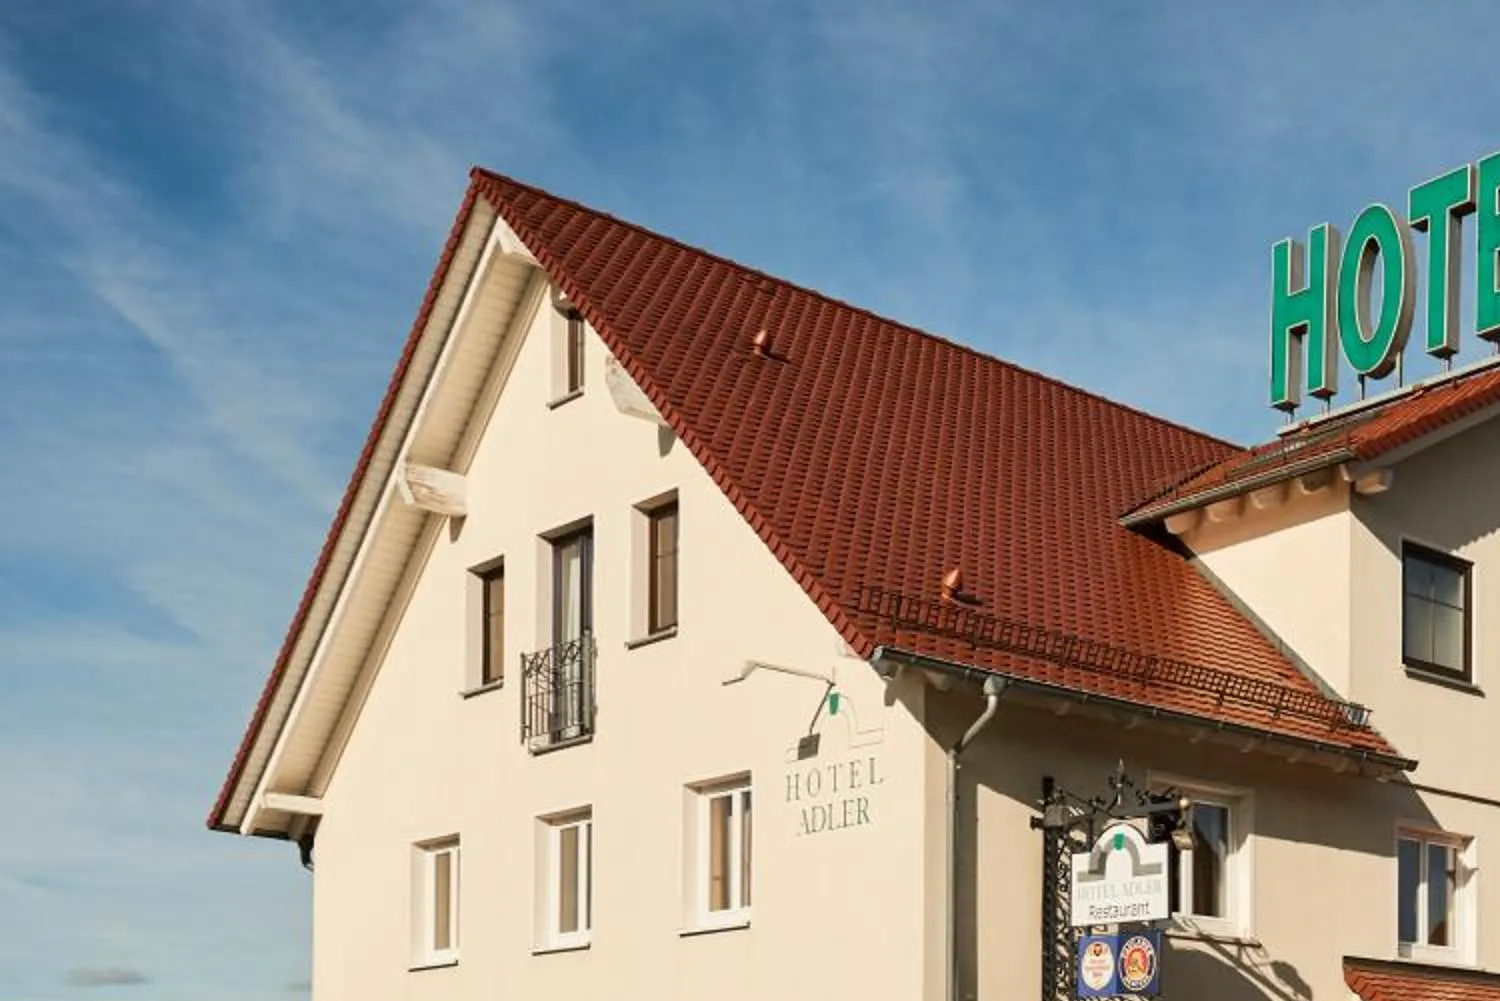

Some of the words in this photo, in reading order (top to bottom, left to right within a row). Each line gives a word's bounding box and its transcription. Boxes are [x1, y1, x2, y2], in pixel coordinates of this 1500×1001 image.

[785, 756, 885, 803] HOTEL
[796, 797, 871, 836] ADLER
[1088, 901, 1151, 920] Restaurant
